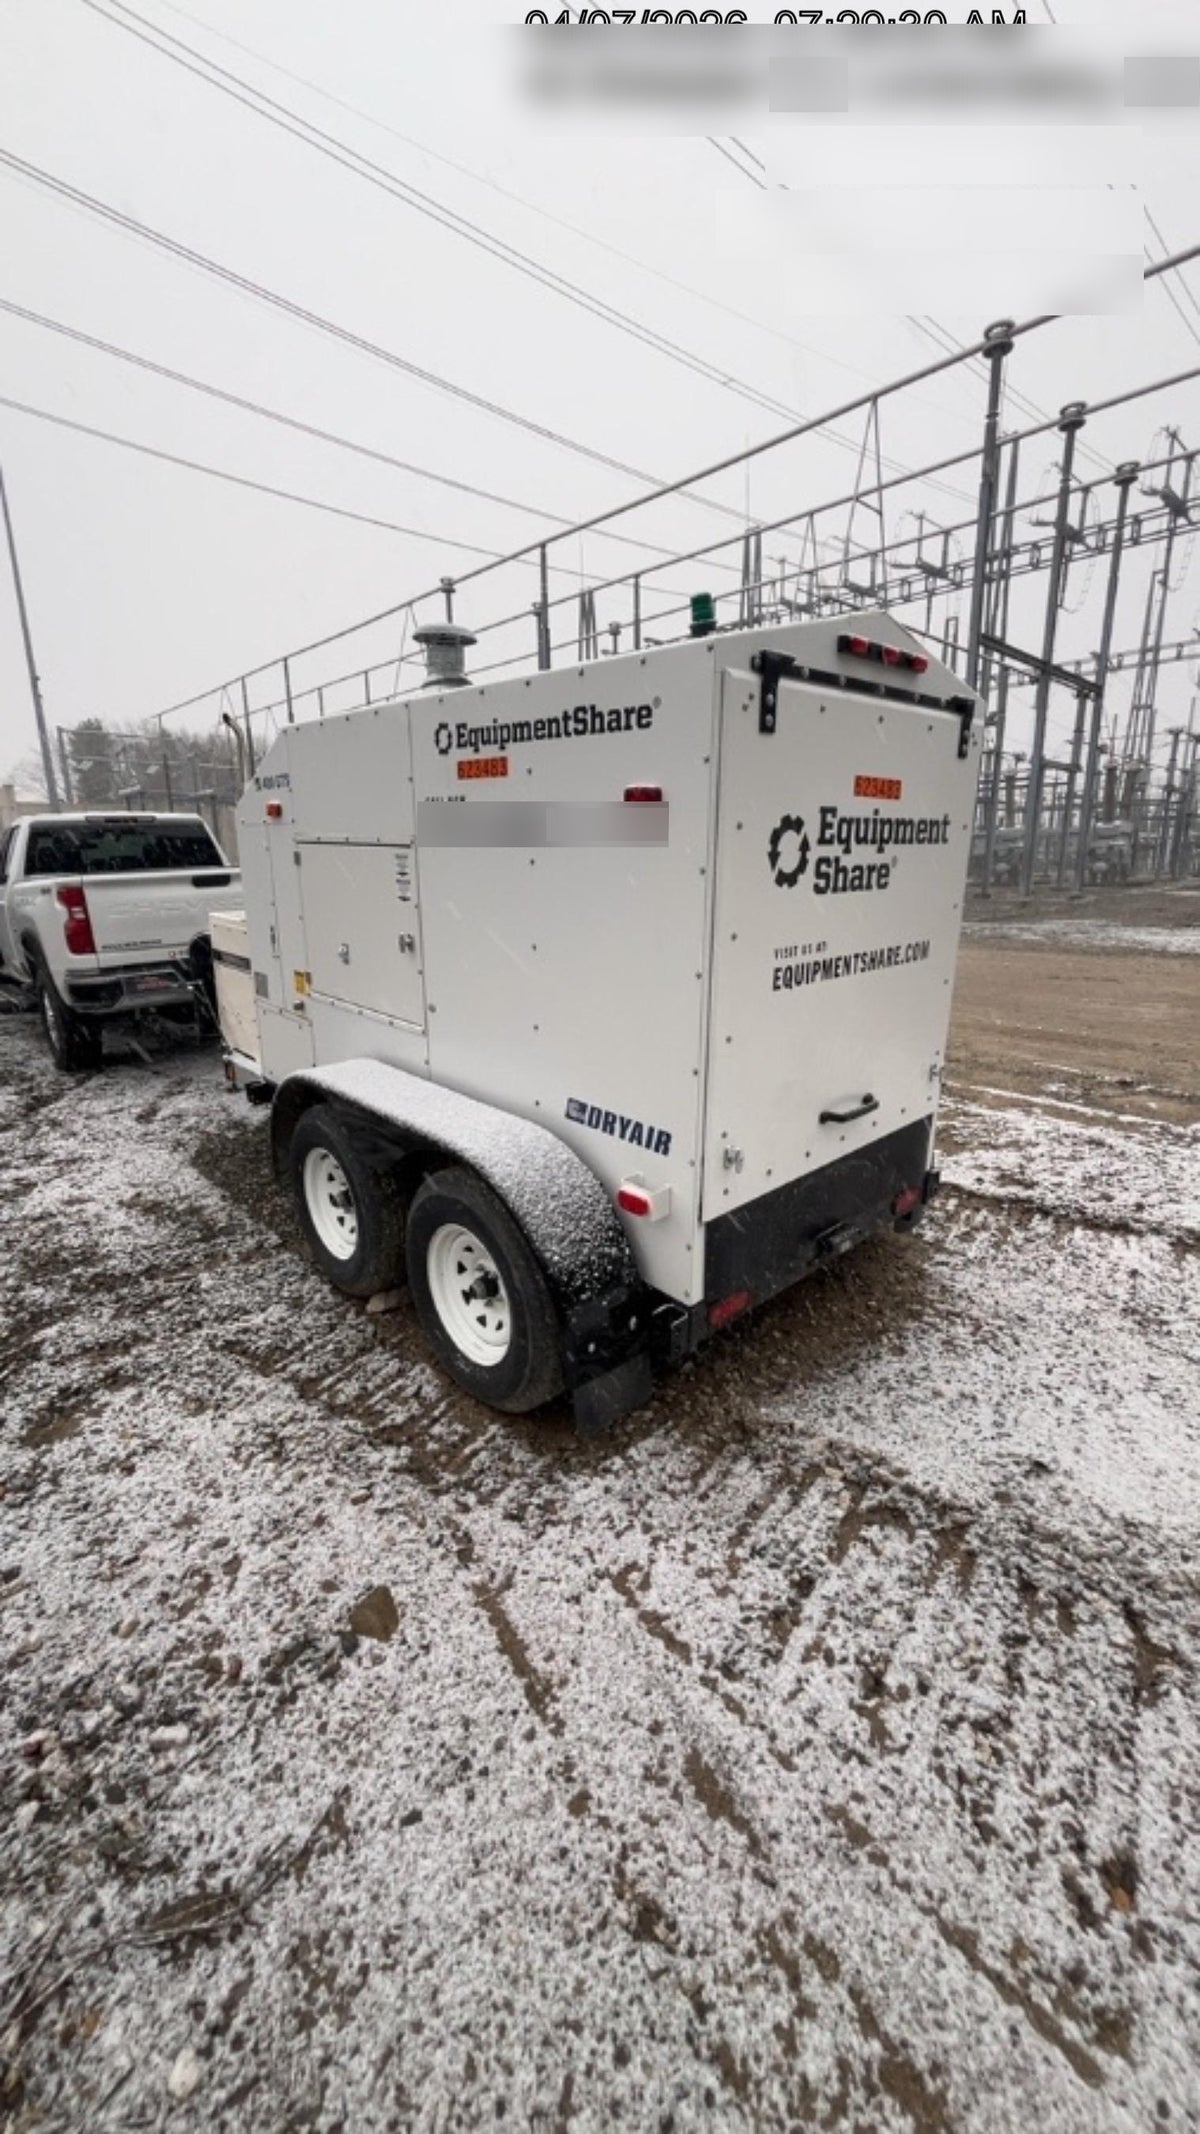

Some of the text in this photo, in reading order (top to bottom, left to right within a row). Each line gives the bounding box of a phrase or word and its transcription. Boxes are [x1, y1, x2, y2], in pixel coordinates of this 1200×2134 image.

[456, 703, 653, 752] EquipmentShare
[817, 806, 951, 854] Equipment
[813, 856, 890, 894] Share
[772, 939, 931, 992] EQUIPMENTSHARE.COM
[587, 1105, 672, 1157] DRYAIR
